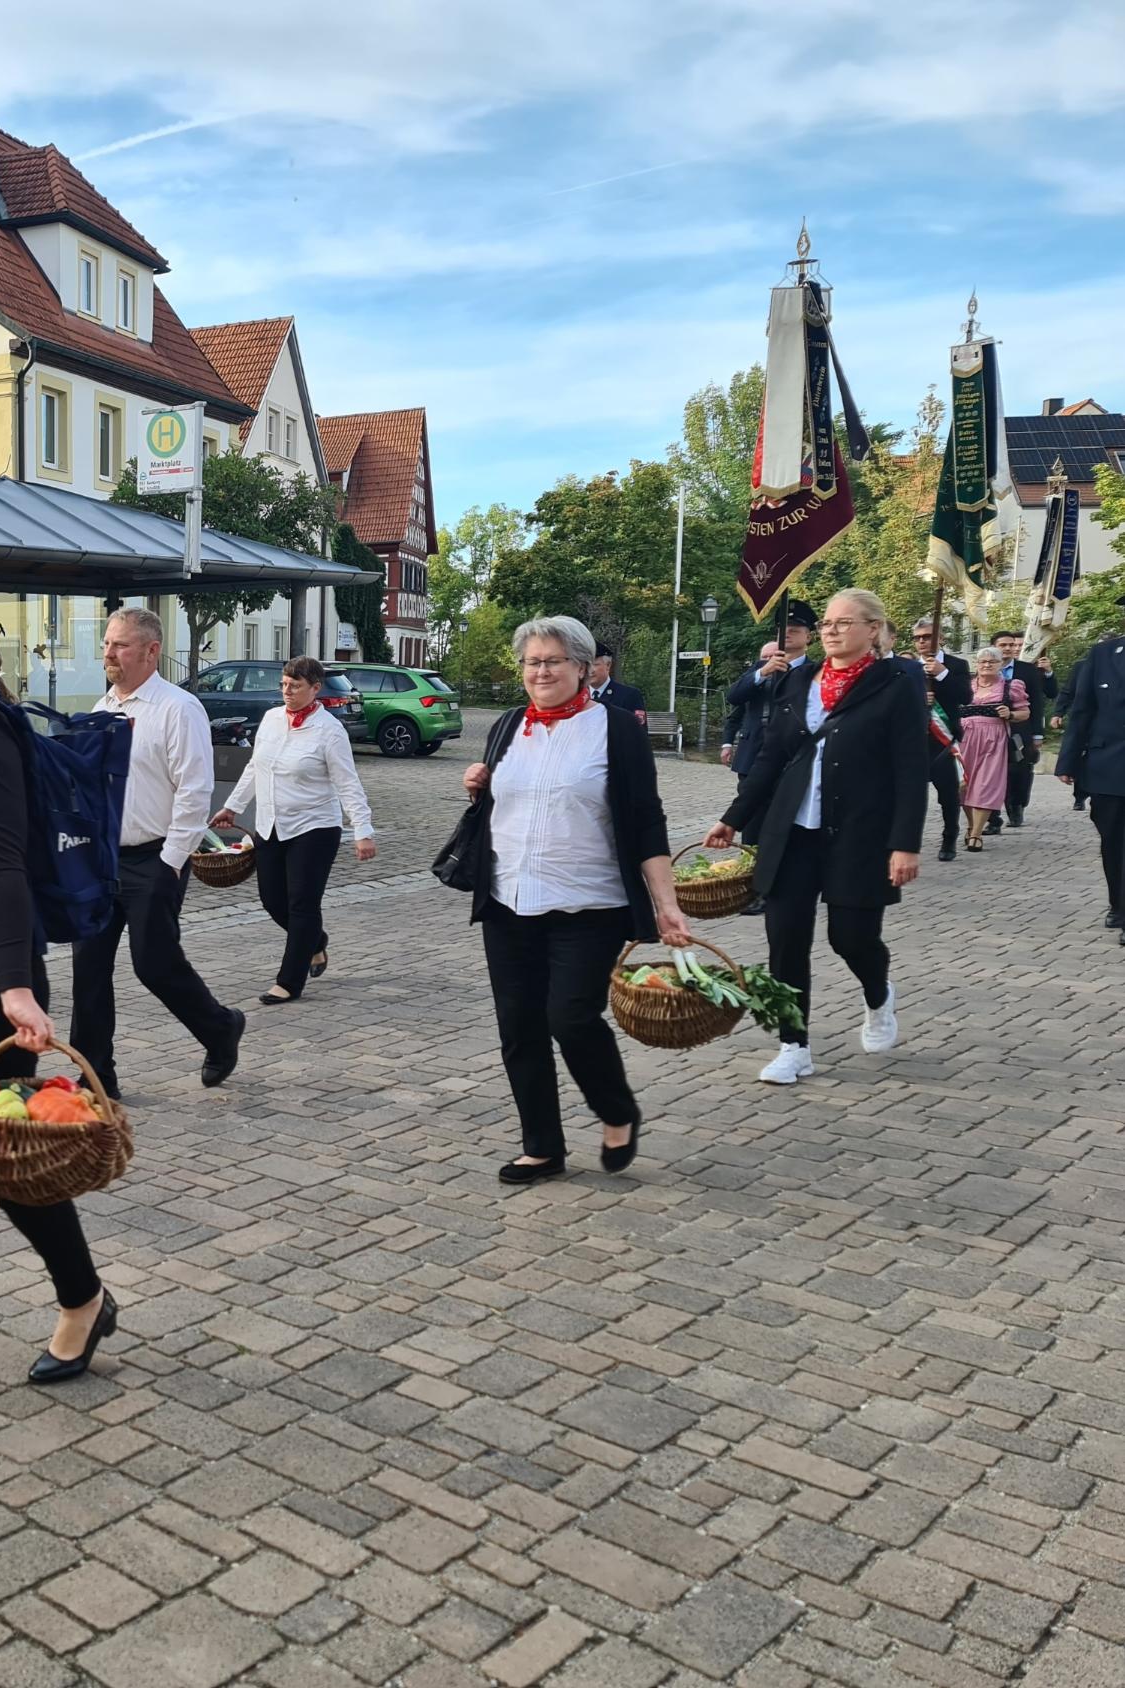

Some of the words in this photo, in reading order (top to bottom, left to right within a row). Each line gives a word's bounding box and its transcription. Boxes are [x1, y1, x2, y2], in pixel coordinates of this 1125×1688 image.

[158, 418, 174, 448] H
[150, 460, 182, 468] Marktplatz
[776, 507, 809, 531] ZUR
